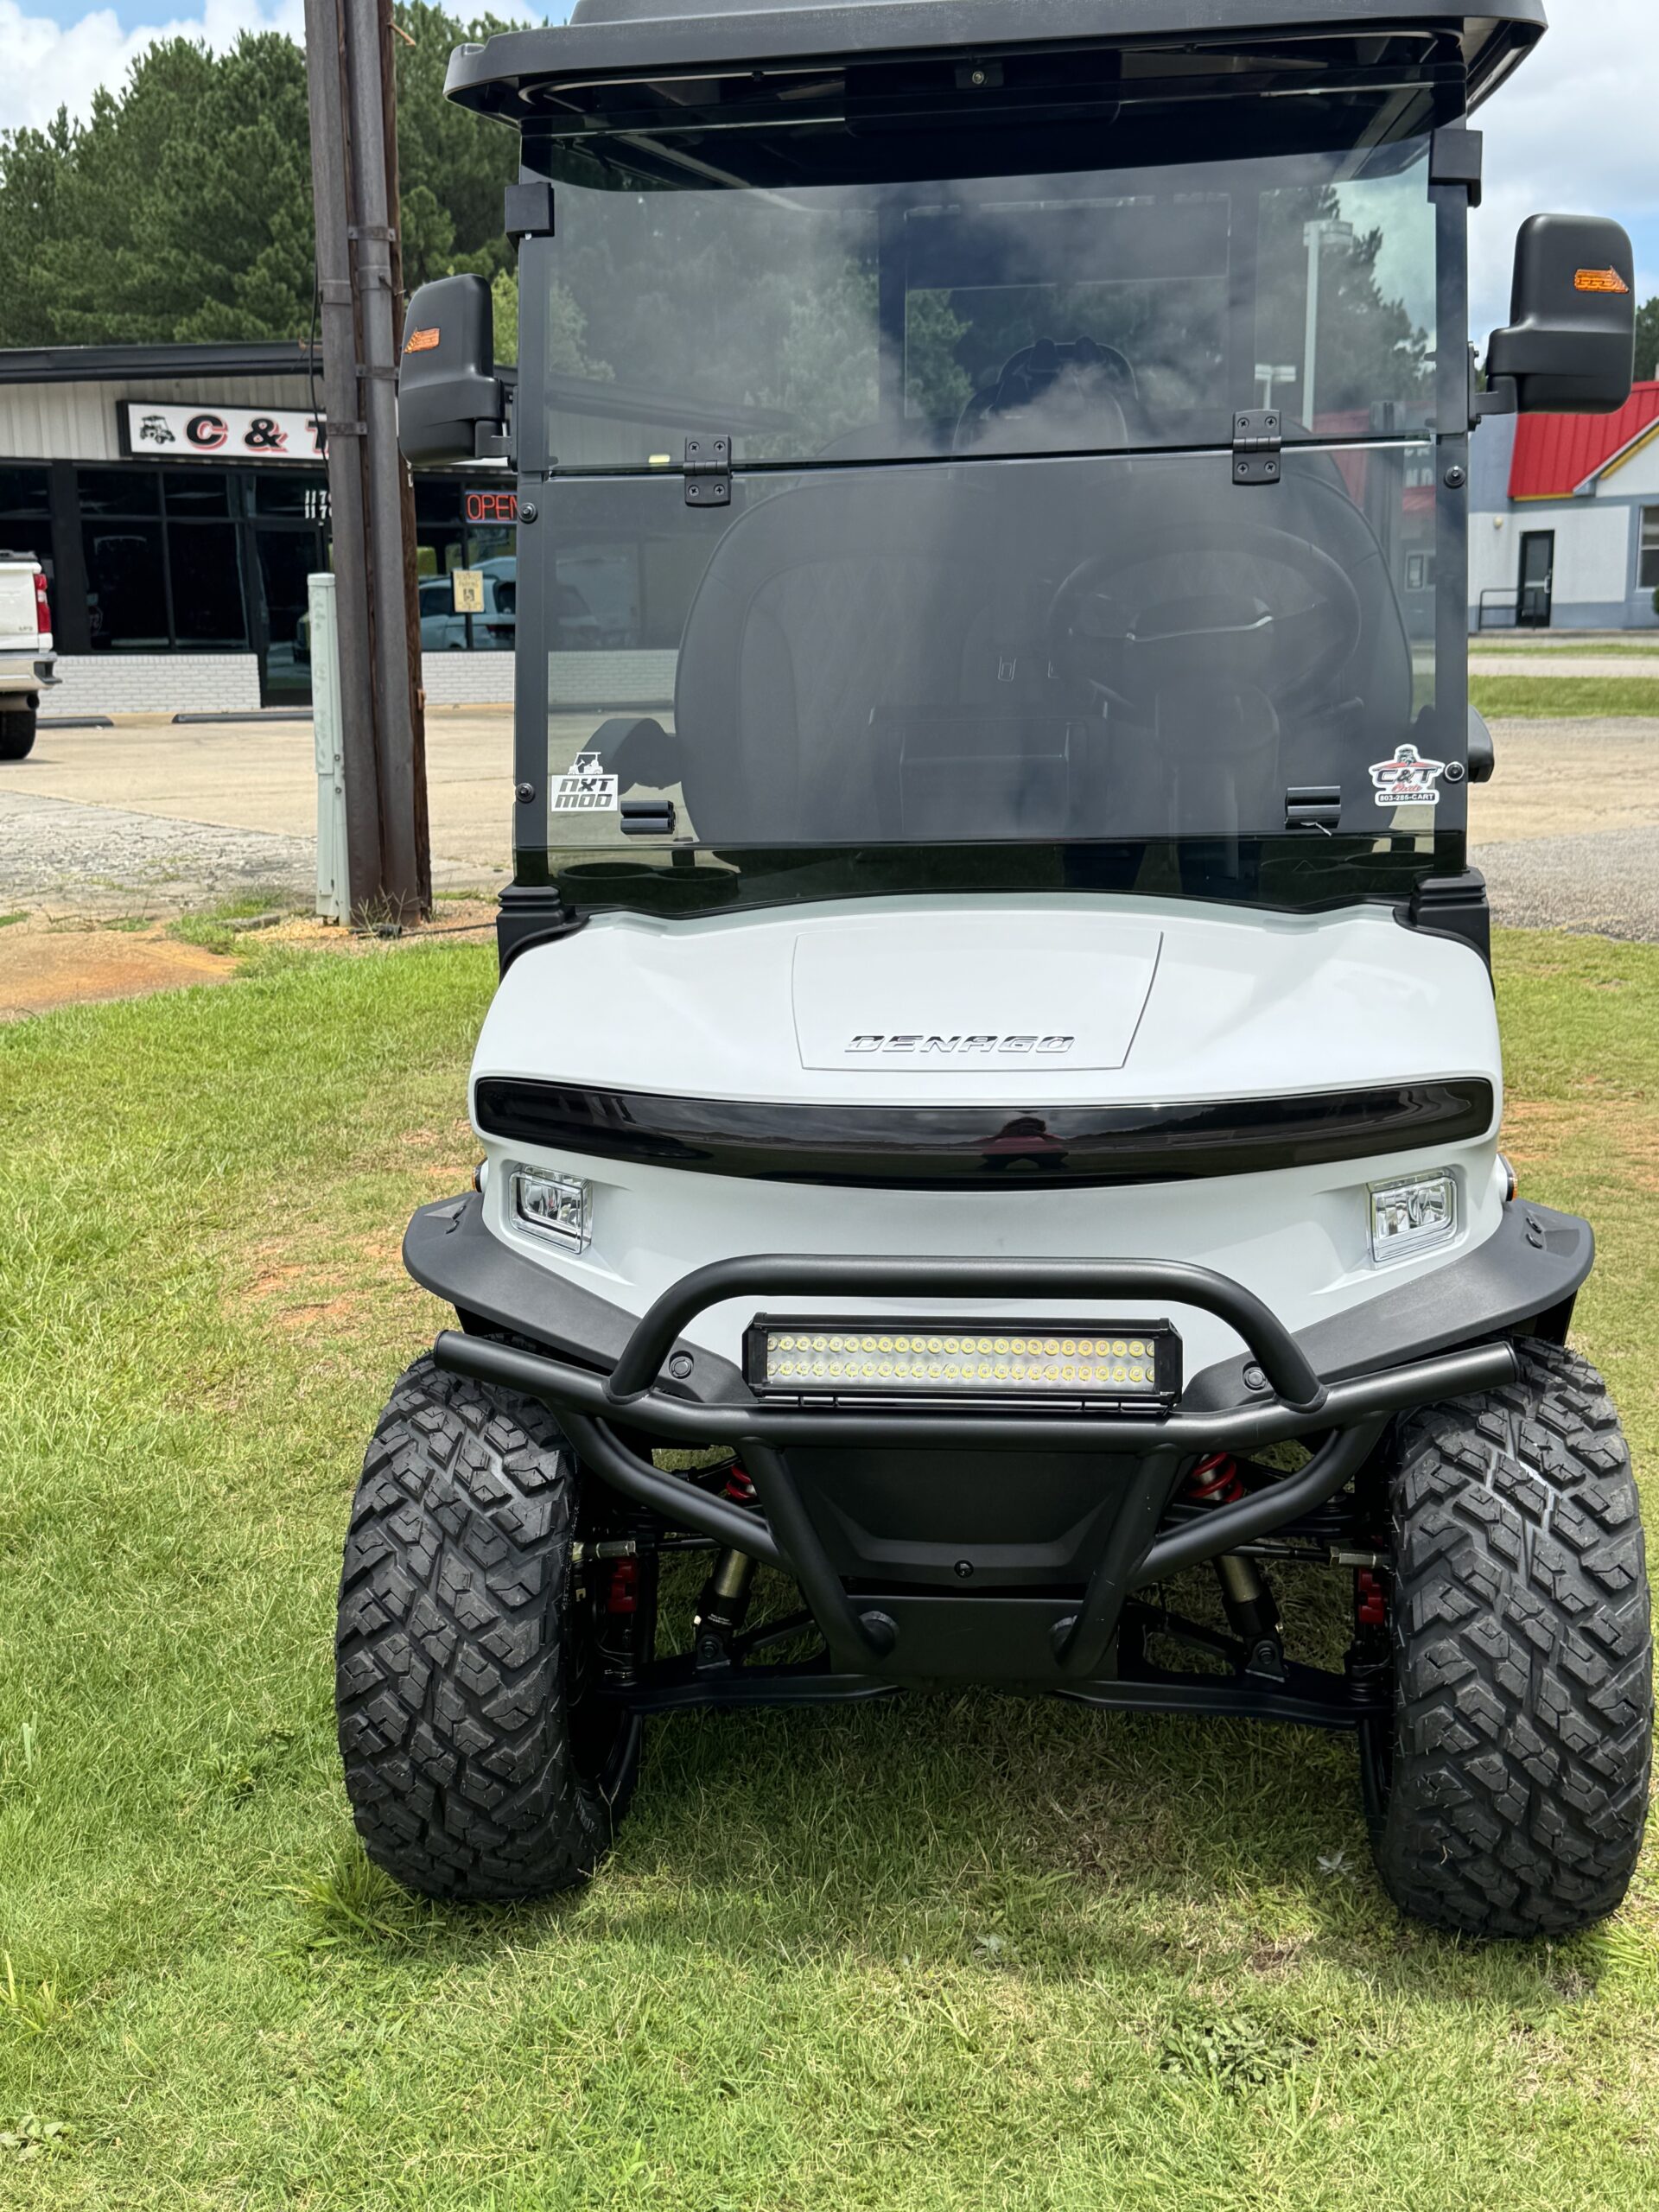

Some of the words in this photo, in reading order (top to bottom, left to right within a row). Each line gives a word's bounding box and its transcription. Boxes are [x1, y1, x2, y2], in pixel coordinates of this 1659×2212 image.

[186, 414, 228, 450] C
[244, 418, 289, 453] &
[305, 489, 332, 505] 117
[305, 505, 333, 519] 117
[1377, 767, 1439, 785] C&T
[559, 778, 614, 792] NXT
[555, 793, 613, 809] MOD
[844, 1034, 1076, 1053] DENAGO
